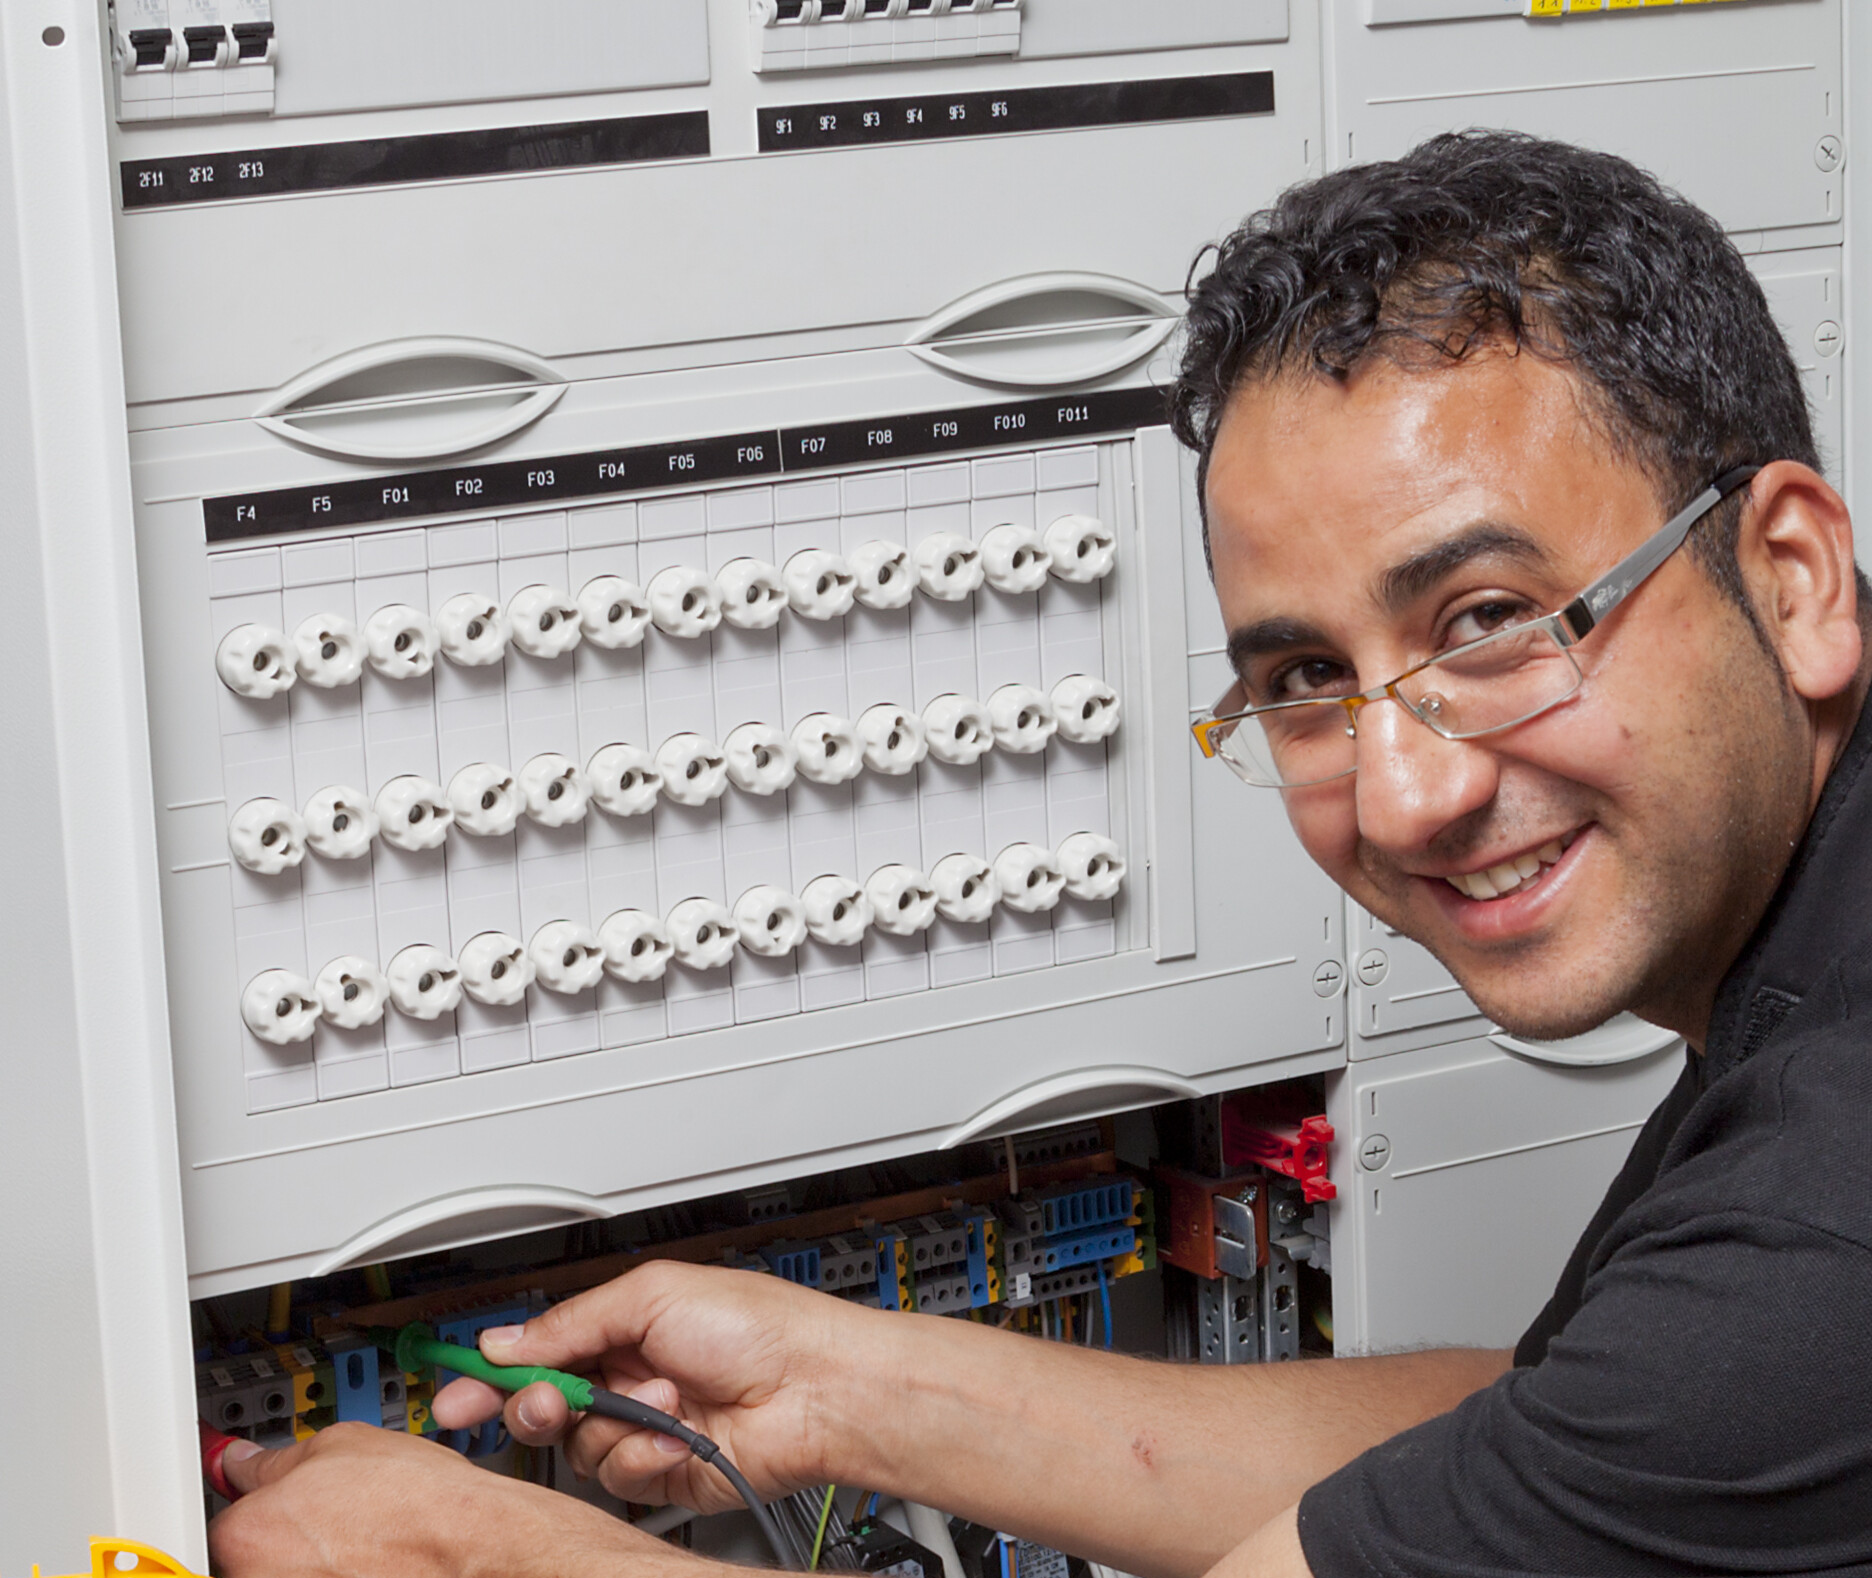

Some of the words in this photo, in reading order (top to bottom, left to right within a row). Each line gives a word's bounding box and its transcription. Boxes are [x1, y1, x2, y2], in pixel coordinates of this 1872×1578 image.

[776, 119, 792, 134] 9F1
[820, 115, 836, 131] 9F2
[863, 112, 880, 127] 9F3
[906, 108, 923, 124] 9F4
[949, 105, 965, 120] 9F5
[991, 102, 1008, 117] 9F6
[139, 171, 164, 187] 2F11
[189, 166, 214, 183] 2F12
[239, 161, 264, 179] 2F13
[801, 438, 826, 454] F07
[868, 430, 893, 446] F08
[933, 422, 958, 437] F09
[994, 413, 1026, 430] F010
[1057, 406, 1089, 423] F011
[237, 506, 256, 522] F4
[312, 496, 332, 512] F5
[382, 487, 409, 504] F01
[455, 479, 482, 496] F02
[528, 470, 555, 487] F03
[599, 462, 625, 479] F04
[669, 454, 695, 471] F05
[737, 446, 764, 463] F06
